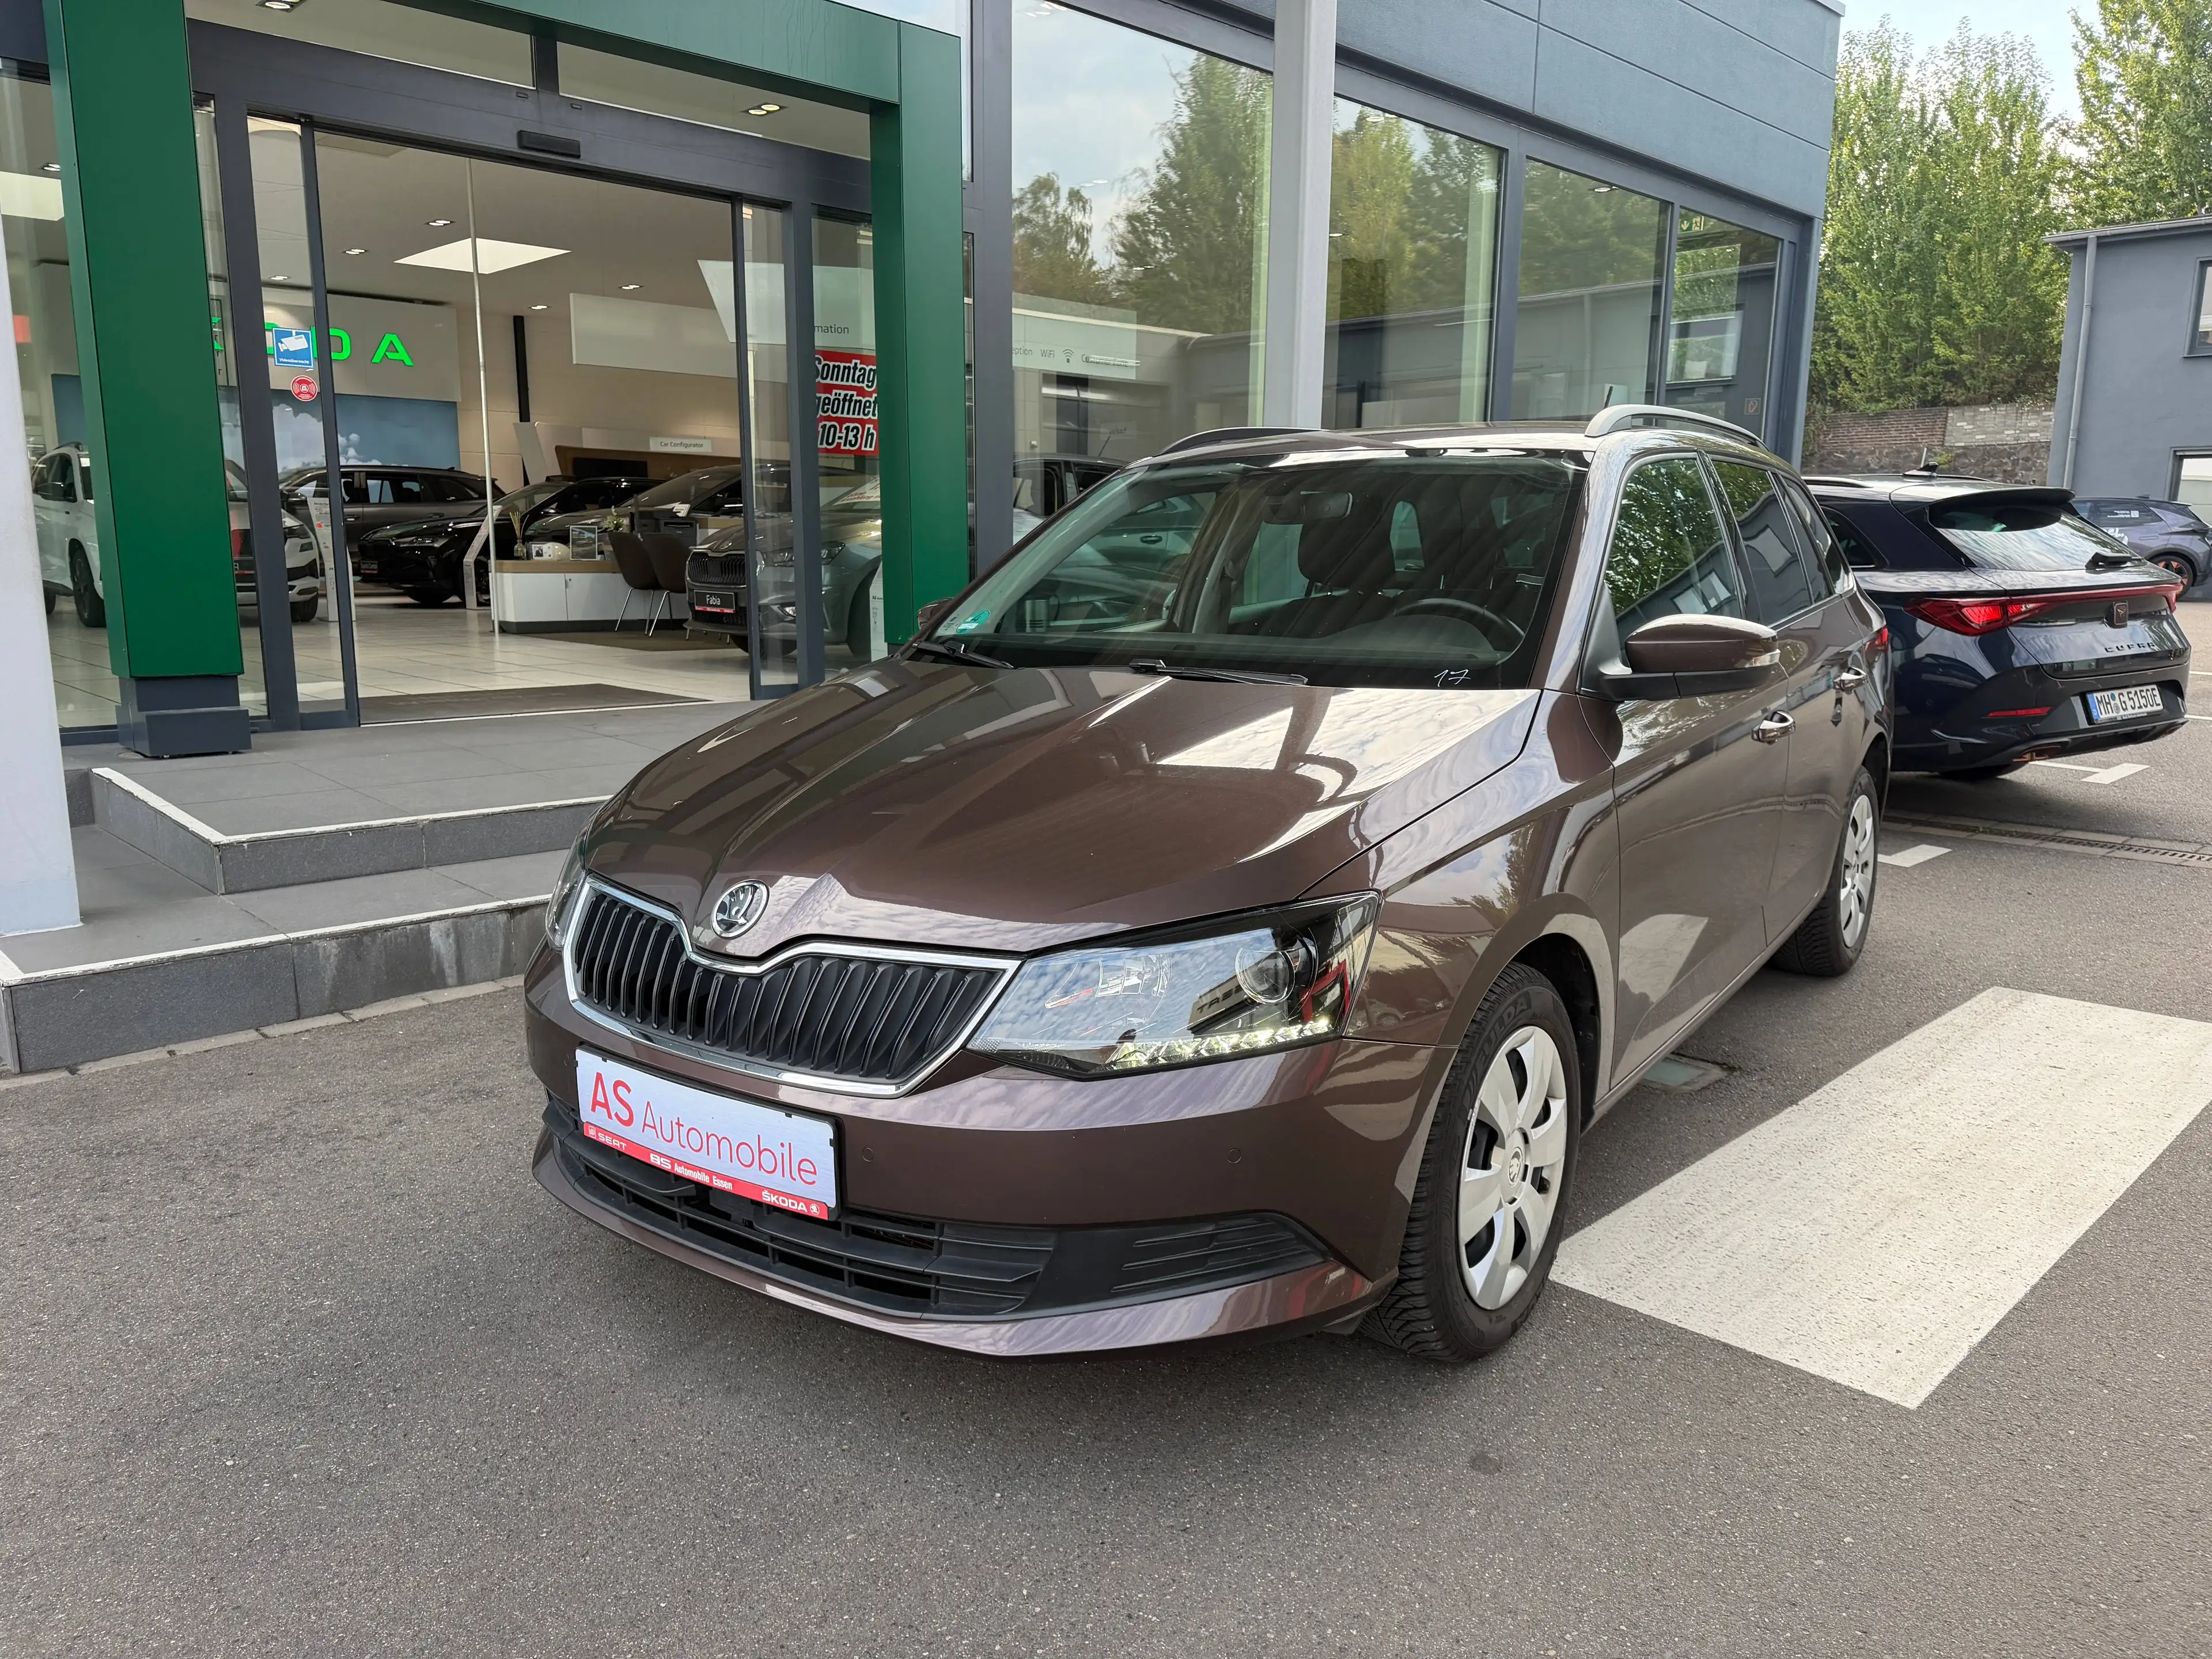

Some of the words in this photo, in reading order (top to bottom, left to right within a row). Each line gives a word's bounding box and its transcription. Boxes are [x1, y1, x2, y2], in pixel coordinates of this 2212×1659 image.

[1040, 349, 1055, 358] WiFi
[815, 357, 877, 389] Sonntag
[819, 423, 860, 448] 10-13
[864, 427, 874, 449] h
[706, 594, 721, 605] Fabia
[2104, 642, 2155, 653] CUPRA
[1434, 669, 1472, 687] 17
[2096, 694, 2114, 716] MH
[2118, 692, 2128, 712] G
[2128, 687, 2161, 710] 5150E
[590, 1071, 634, 1127] AS
[641, 1101, 817, 1185] Automobile
[598, 1132, 627, 1150] SEAT
[674, 1163, 710, 1183] Automobile
[713, 1175, 733, 1190] Essen
[762, 1190, 808, 1213] ŠKODA
